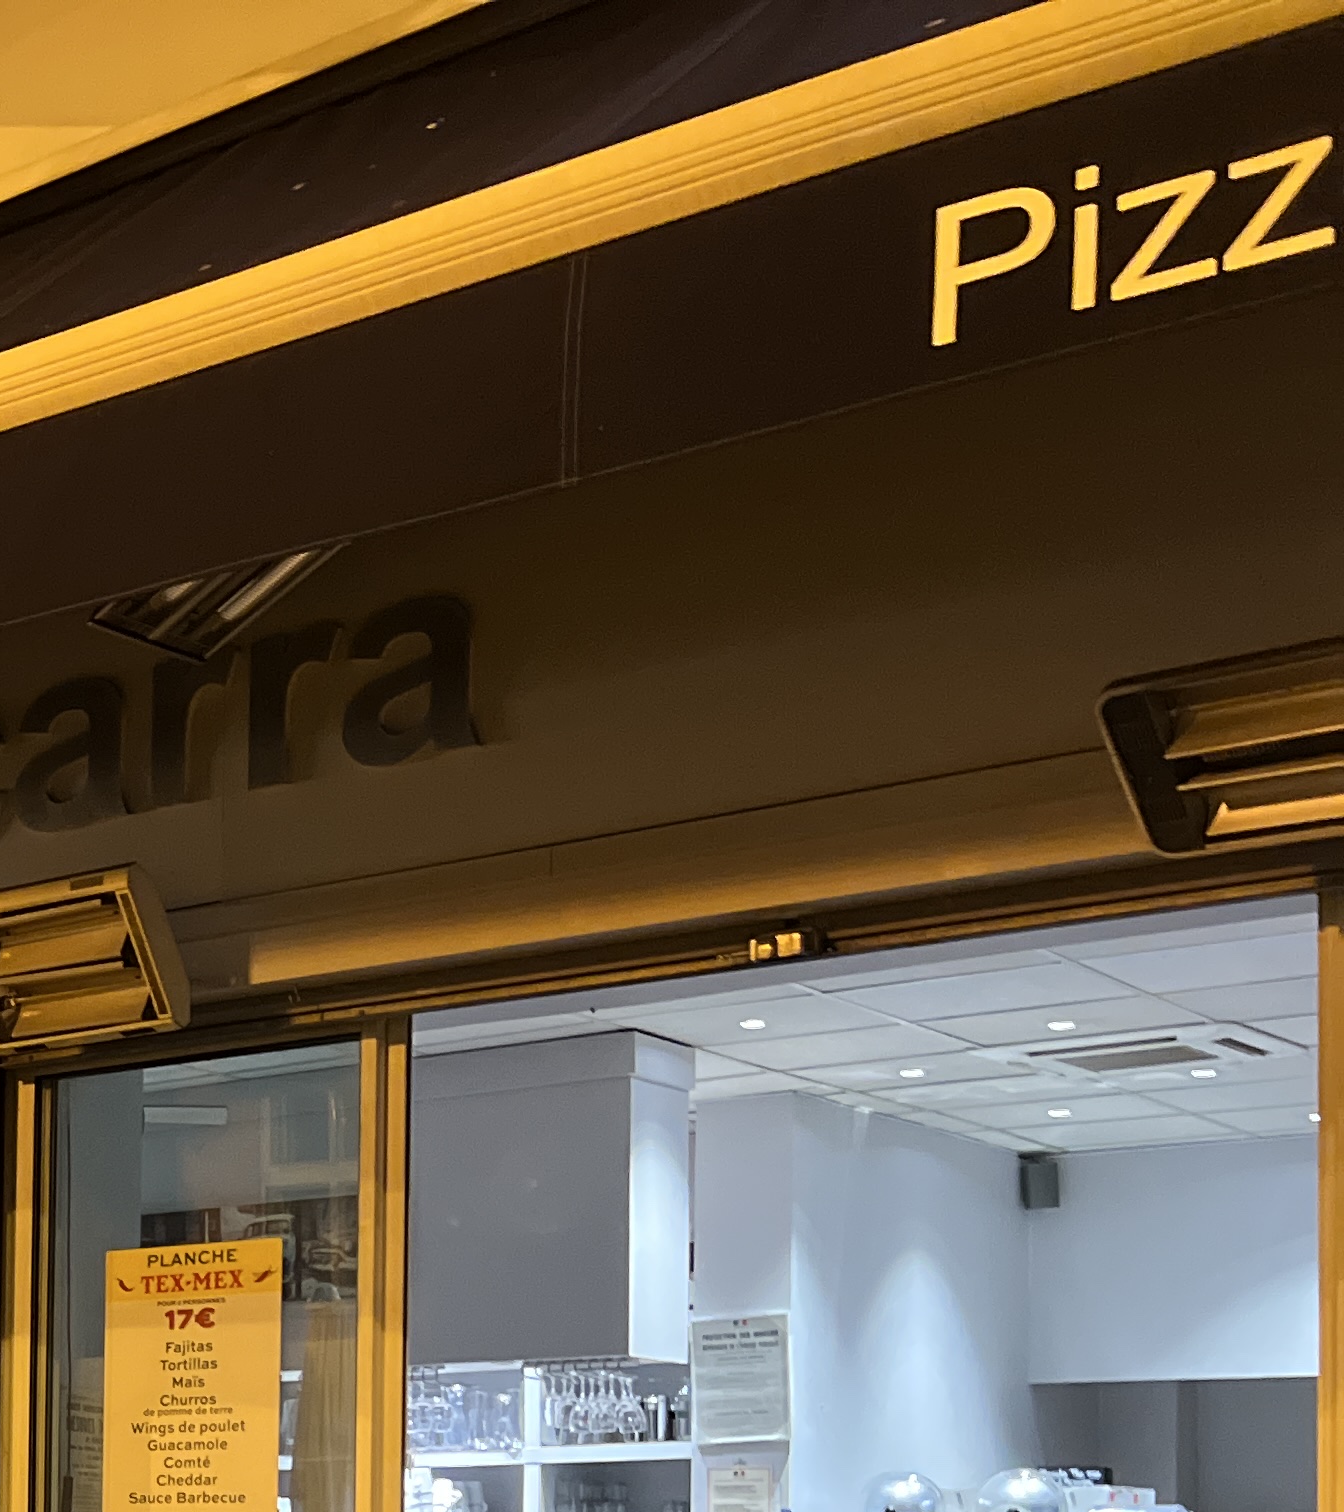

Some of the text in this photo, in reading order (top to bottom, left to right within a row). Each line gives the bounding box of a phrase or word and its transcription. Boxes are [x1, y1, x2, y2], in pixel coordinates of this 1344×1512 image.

[931, 134, 1336, 347] Pizz
[147, 1248, 237, 1268] PLANCHE
[164, 1307, 216, 1330] 17€
[165, 1340, 213, 1356] Fajitas
[160, 1357, 218, 1371] Tortillas
[172, 1376, 205, 1388] Maïs
[160, 1394, 217, 1406] Churros
[143, 1406, 233, 1418] de pomme de terre
[130, 1419, 246, 1437] Wings de poulet
[147, 1438, 228, 1452] Guacamole
[163, 1455, 211, 1469] Comté
[156, 1474, 218, 1487] Cheddar
[128, 1491, 246, 1504] Sauce Barbecue
